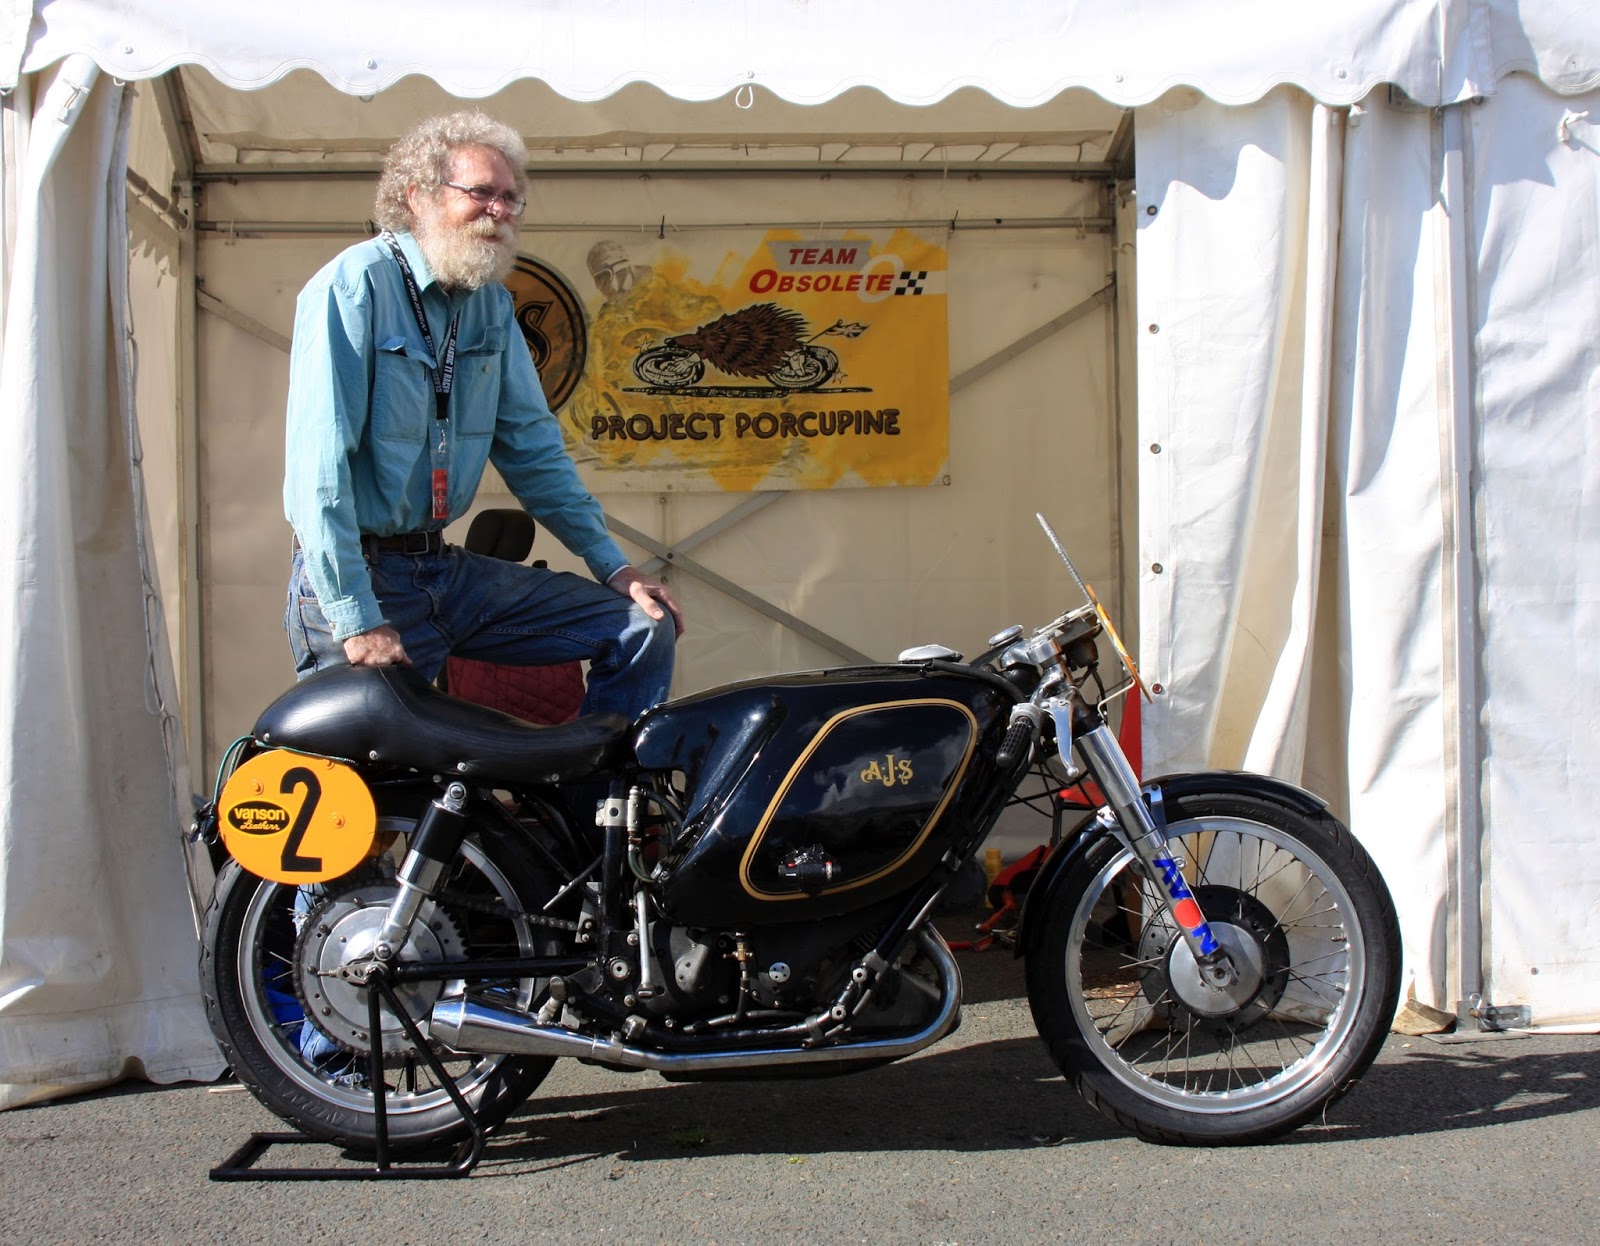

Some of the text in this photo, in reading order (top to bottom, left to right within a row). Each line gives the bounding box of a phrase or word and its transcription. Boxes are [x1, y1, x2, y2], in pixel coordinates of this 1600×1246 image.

[788, 248, 858, 265] TEAM
[749, 269, 895, 294] OBSOLETE
[591, 409, 901, 441] PROJECT PORCUPINE
[234, 807, 286, 821] vanson
[280, 767, 322, 872] 2
[240, 820, 281, 831] Leathers
